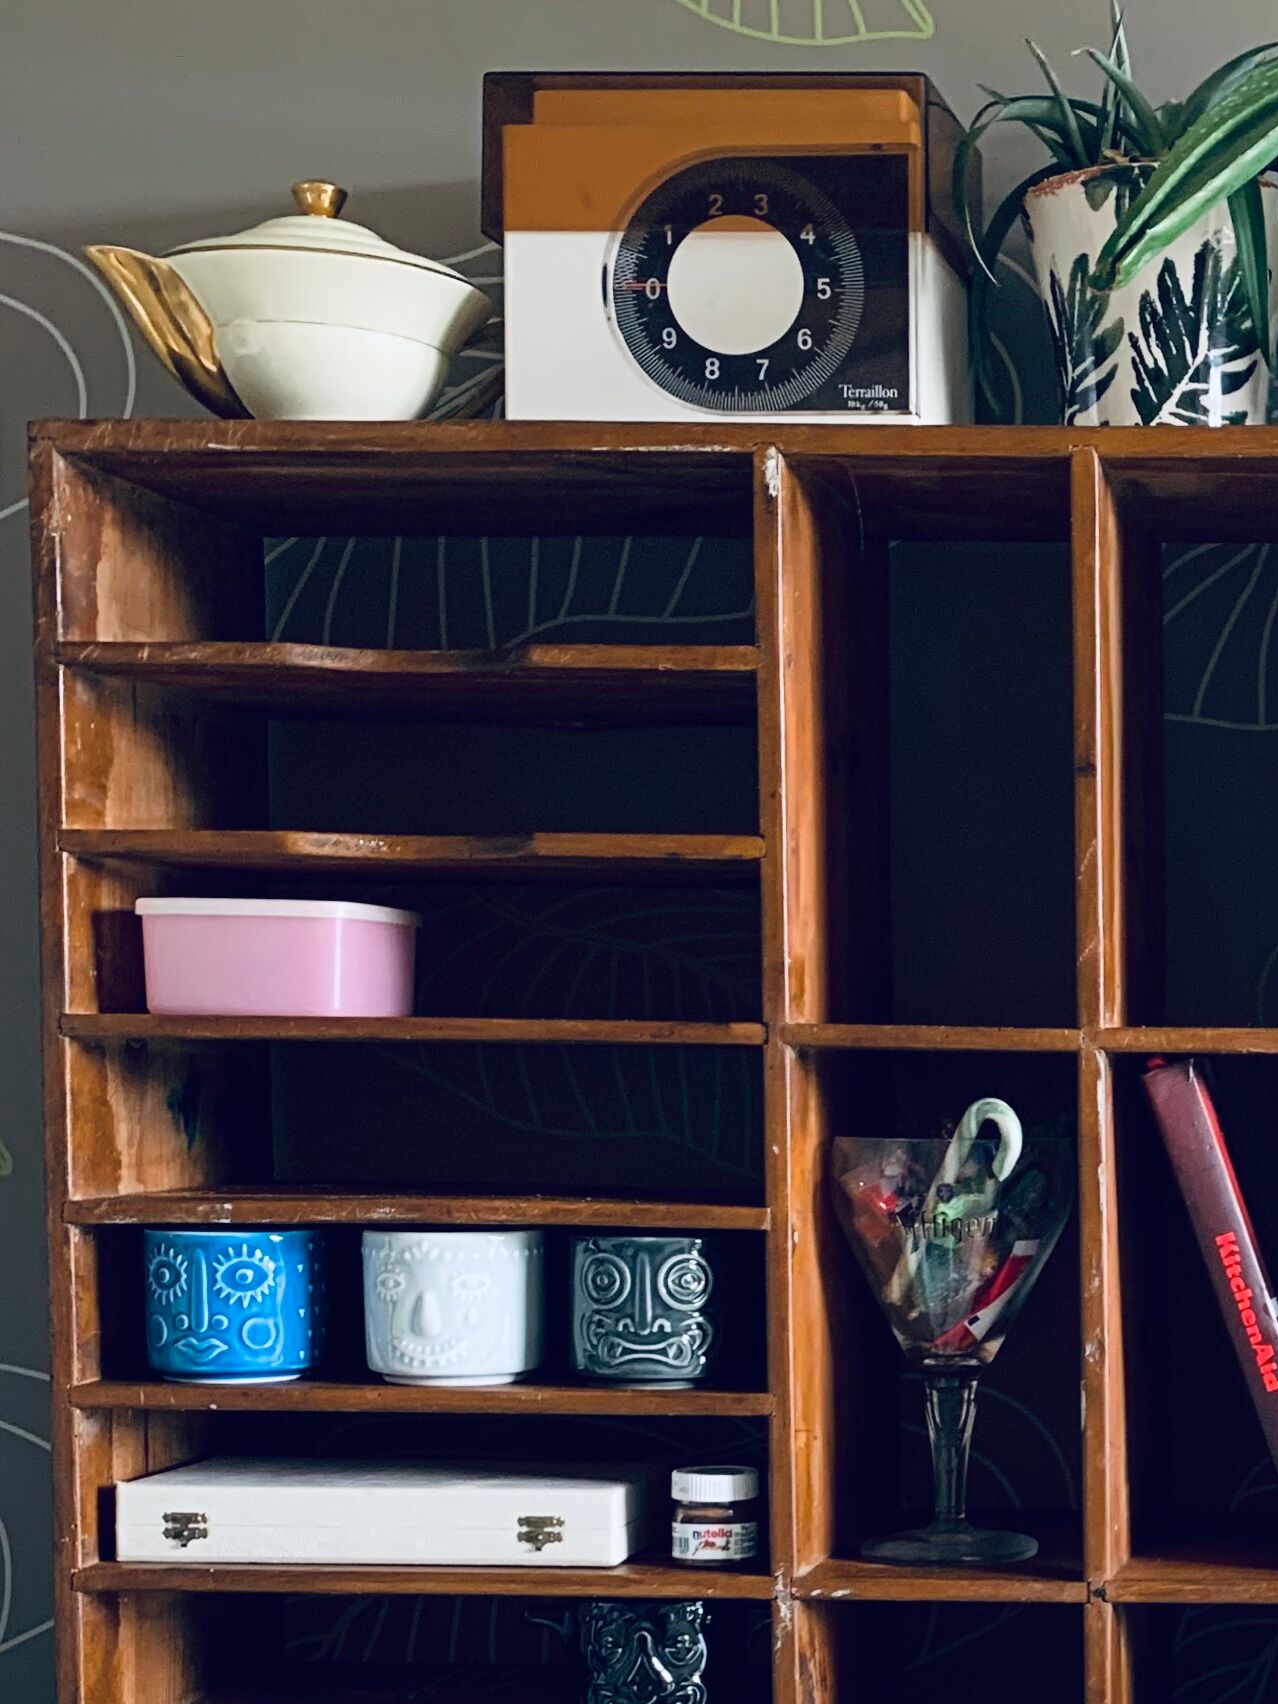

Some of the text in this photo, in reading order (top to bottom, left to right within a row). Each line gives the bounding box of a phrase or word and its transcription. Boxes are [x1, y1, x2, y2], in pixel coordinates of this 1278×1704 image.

[708, 194, 723, 215] 2
[754, 194, 769, 215] 3
[664, 224, 673, 245] 1
[800, 223, 816, 245] 4
[645, 277, 661, 300] 0
[816, 277, 832, 300] 5
[662, 327, 677, 350] 9
[797, 328, 813, 350] 6
[705, 357, 720, 380] 8
[756, 358, 770, 380] 7
[838, 384, 898, 398] Terraillon
[692, 1527, 733, 1540] nutella
